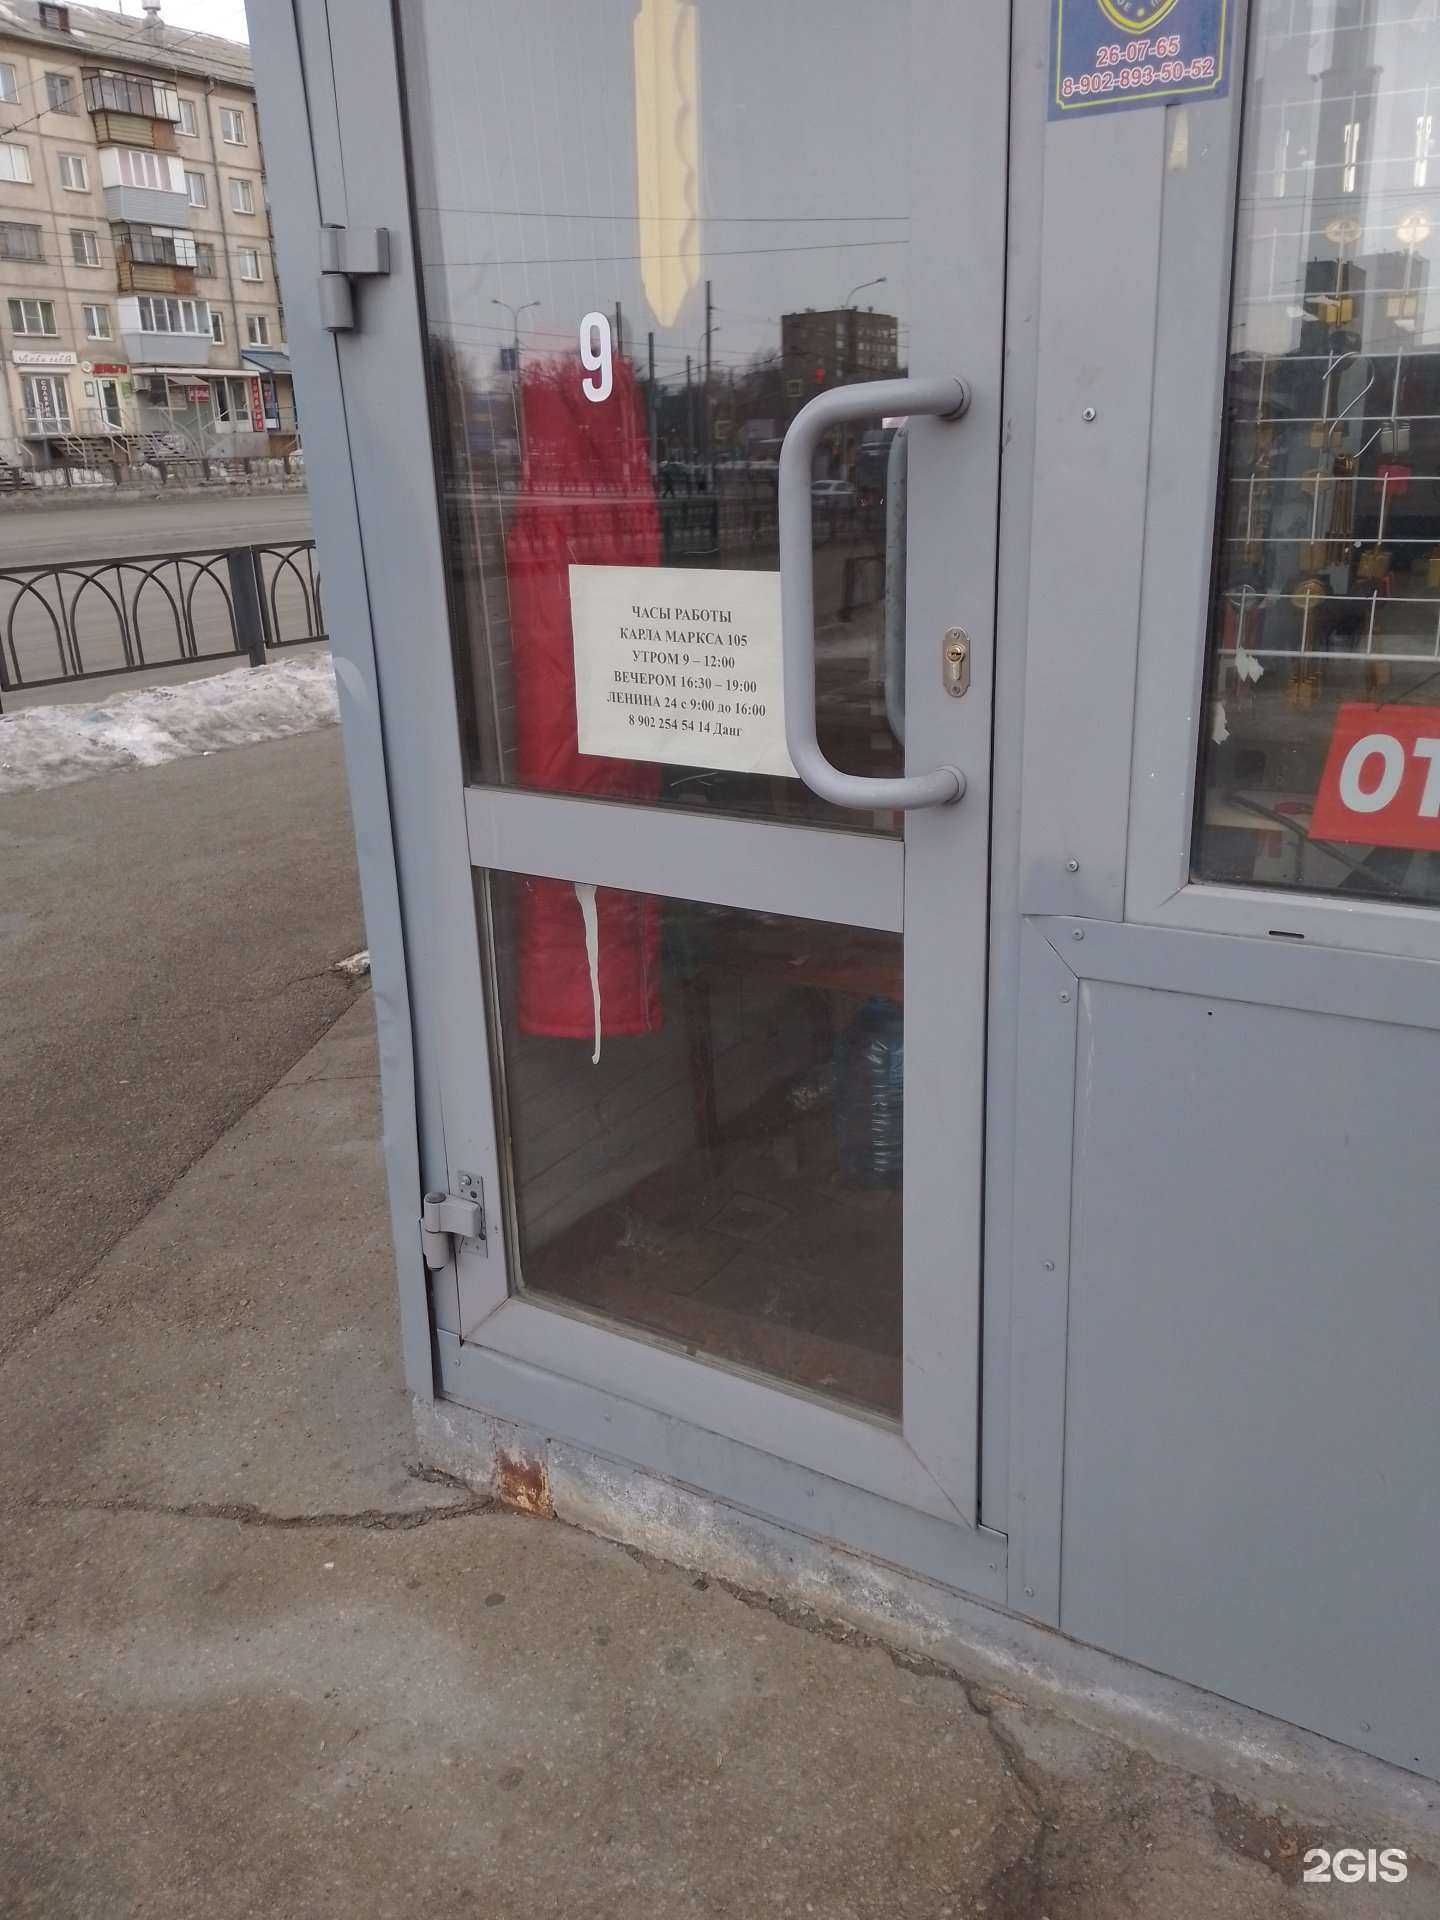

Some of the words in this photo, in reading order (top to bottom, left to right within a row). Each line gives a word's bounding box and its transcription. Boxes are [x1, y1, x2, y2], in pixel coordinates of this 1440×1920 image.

[1096, 35, 1180, 67] 26-07-65
[1062, 56, 1214, 96] 8-902-893-50-52
[579, 311, 613, 402] 9
[632, 605, 670, 620] ЧАСЫ
[675, 608, 732, 623] РАБОТЫ
[620, 627, 662, 642] КАРЛА
[665, 630, 723, 645] МАРКСА
[727, 634, 748, 646] 105
[632, 650, 679, 665] УТРОМ
[682, 653, 690, 665] 9
[704, 655, 735, 668] 12:00
[614, 670, 676, 687] ВЕЧЕРОМ
[680, 676, 712, 689] 16:30
[726, 679, 757, 693] 19:00
[606, 691, 661, 708] ЛЕНИНА
[664, 696, 677, 708] 24
[690, 699, 715, 712] 9:00
[717, 704, 731, 715] до
[735, 702, 766, 717] 16:00
[628, 714, 635, 726] 8
[637, 715, 656, 728] 902
[658, 718, 678, 730] 254
[681, 720, 694, 732] 54
[698, 721, 711, 733] 14
[713, 722, 743, 737] Данг
